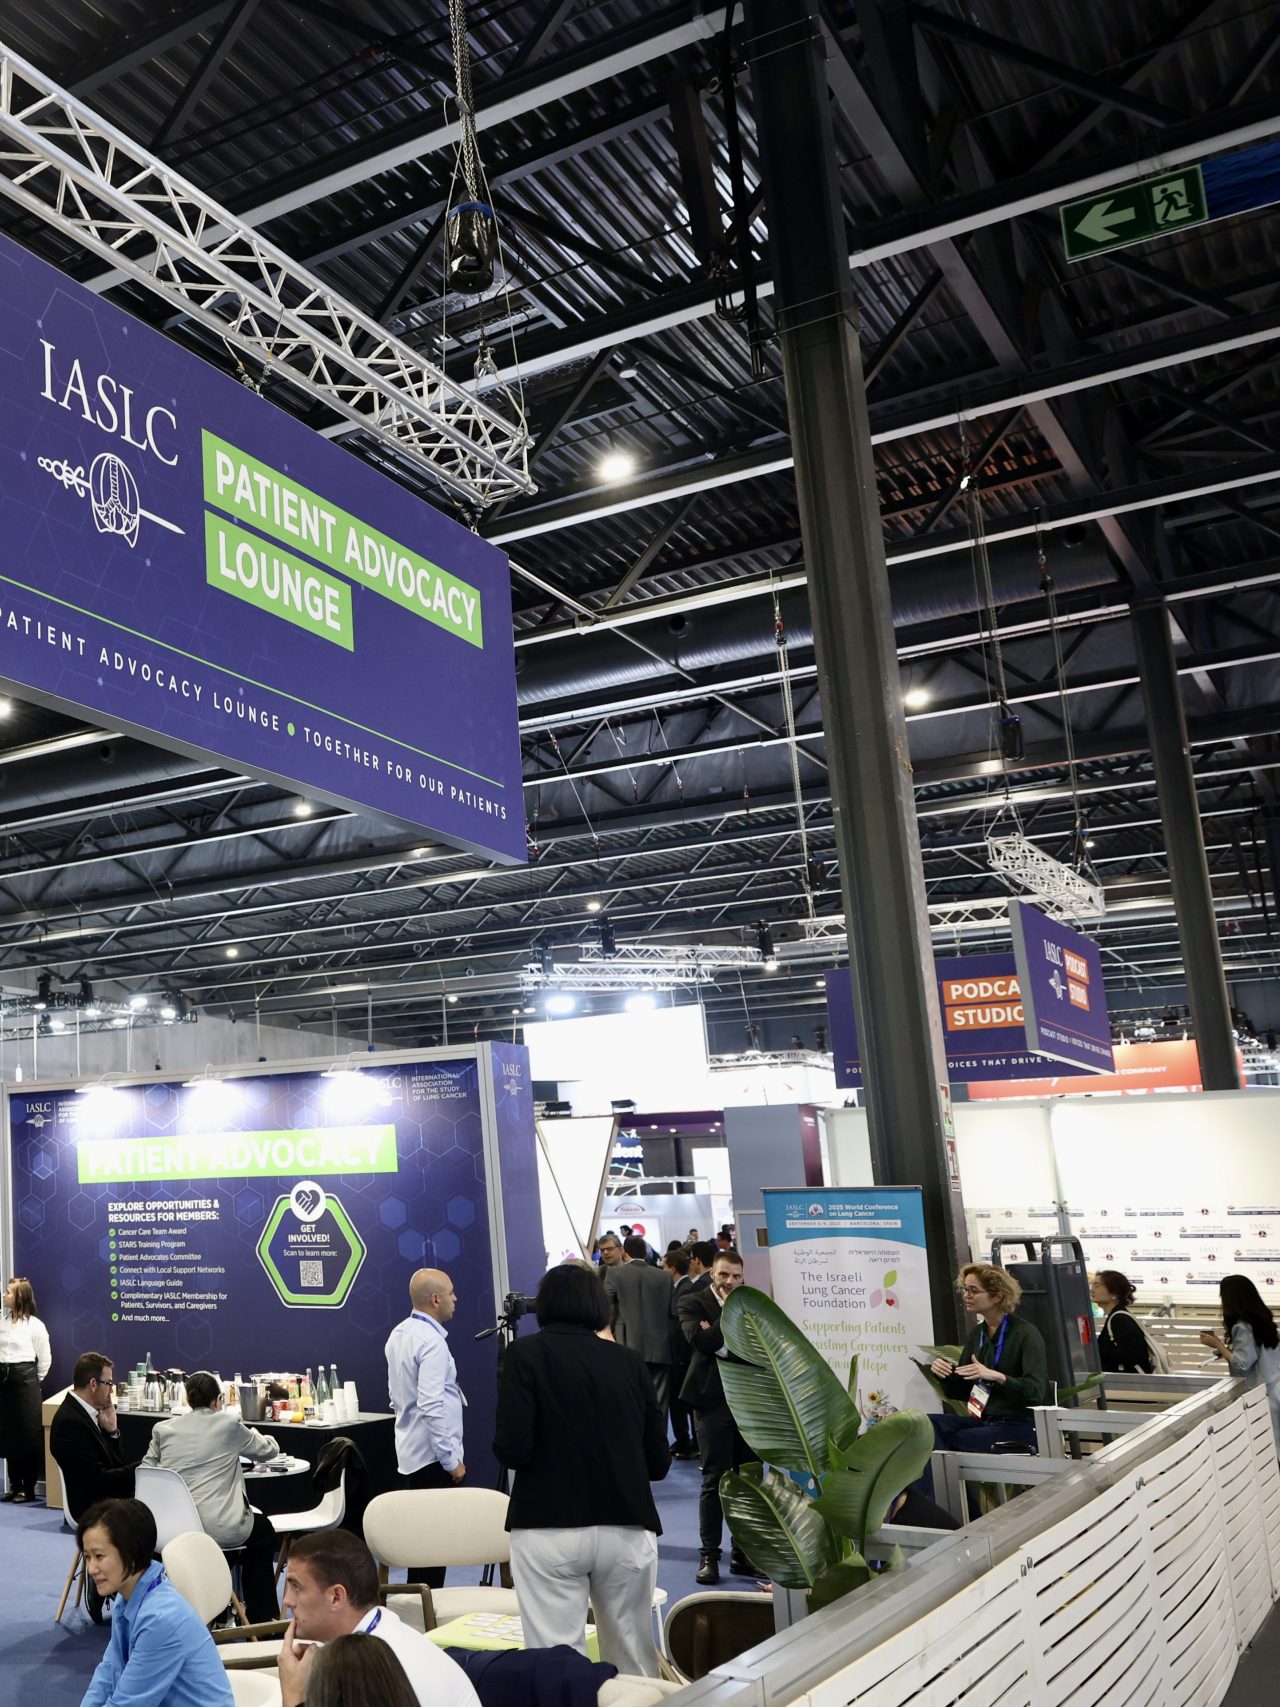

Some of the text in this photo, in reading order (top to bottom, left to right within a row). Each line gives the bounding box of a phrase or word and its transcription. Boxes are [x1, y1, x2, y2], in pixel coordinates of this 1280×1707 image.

[39, 339, 179, 466] IASLC
[216, 449, 476, 633] PATIENT ADVOCACY
[219, 530, 341, 632] LOUNGE
[99, 647, 202, 701] ADVOCACY
[213, 692, 280, 732] LOUNGE
[304, 727, 379, 770] TOGETHER
[387, 760, 413, 783] FOR
[420, 774, 445, 797] OUR
[451, 786, 508, 820] PATIENTS
[1043, 939, 1063, 967] IASLC
[950, 981, 1021, 1000] PODCA
[947, 1060, 977, 1069] OICES
[982, 1058, 1007, 1066] THAT
[1011, 1057, 1042, 1065] DRIVE
[503, 1065, 521, 1077] IASLC
[411, 1073, 460, 1082] INTERNATIONAL
[412, 1080, 453, 1088] ASSOCIATION
[441, 1092, 467, 1100] CANCER
[26, 1102, 51, 1113] IASLC
[88, 1134, 384, 1176] PATIENT ADVOCACY
[108, 1199, 220, 1211] EXPLORE OPPORTUNITIES &
[108, 1211, 219, 1222] RESOURCES FOR MEMBERS:
[168, 1227, 187, 1235] Award
[300, 1225, 316, 1233] GET
[288, 1234, 330, 1243] INVOLVED!
[138, 1241, 160, 1249] Training
[161, 1241, 185, 1249] Program
[173, 1267, 196, 1275] Support
[801, 1272, 863, 1282] The Israeli
[120, 1292, 163, 1300] Complimentary
[182, 1293, 217, 1301] Membership
[802, 1285, 867, 1297] Lung Cancer
[186, 1302, 217, 1310] Caregivers
[803, 1298, 867, 1309] Foundation
[802, 1320, 907, 1338] Supporting Patients
[850, 1340, 909, 1357] Caregivers
[863, 1358, 888, 1376] Hope
